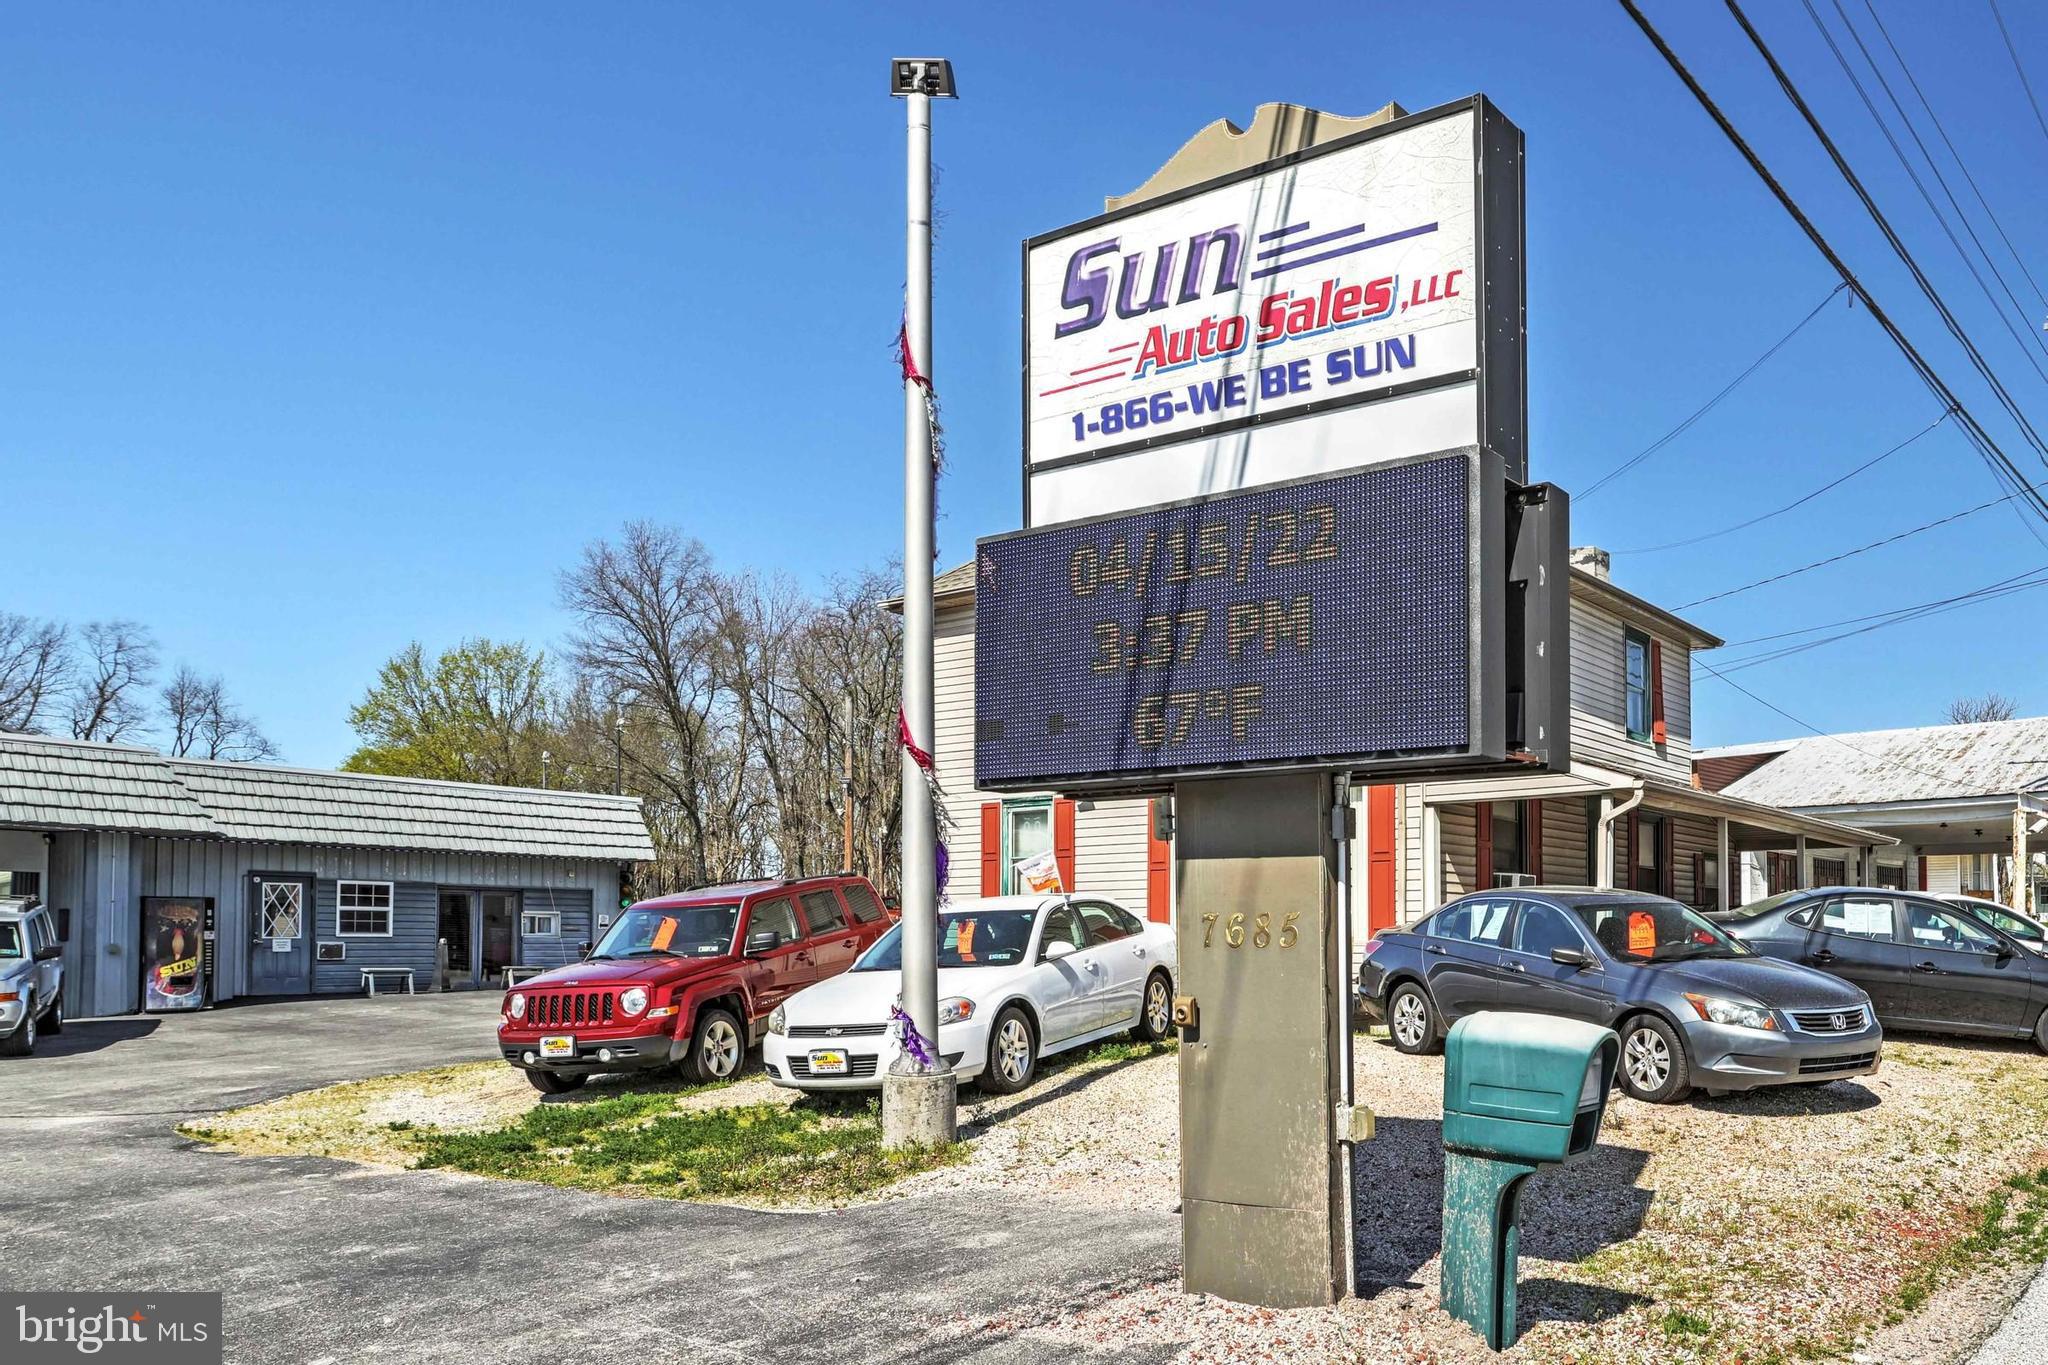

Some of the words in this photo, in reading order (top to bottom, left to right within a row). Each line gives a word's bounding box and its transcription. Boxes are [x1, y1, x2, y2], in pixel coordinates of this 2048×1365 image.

[1055, 222, 1247, 339] Sun
[1133, 314, 1248, 380] Auto
[1256, 275, 1399, 350] Sales
[1072, 373, 1247, 442] 1-866-WE
[1260, 358, 1312, 399] BE
[1326, 333, 1417, 382] SUN
[1069, 502, 1338, 599] 04/15/22
[1227, 594, 1314, 660] PM
[1201, 911, 1301, 949] 7685
